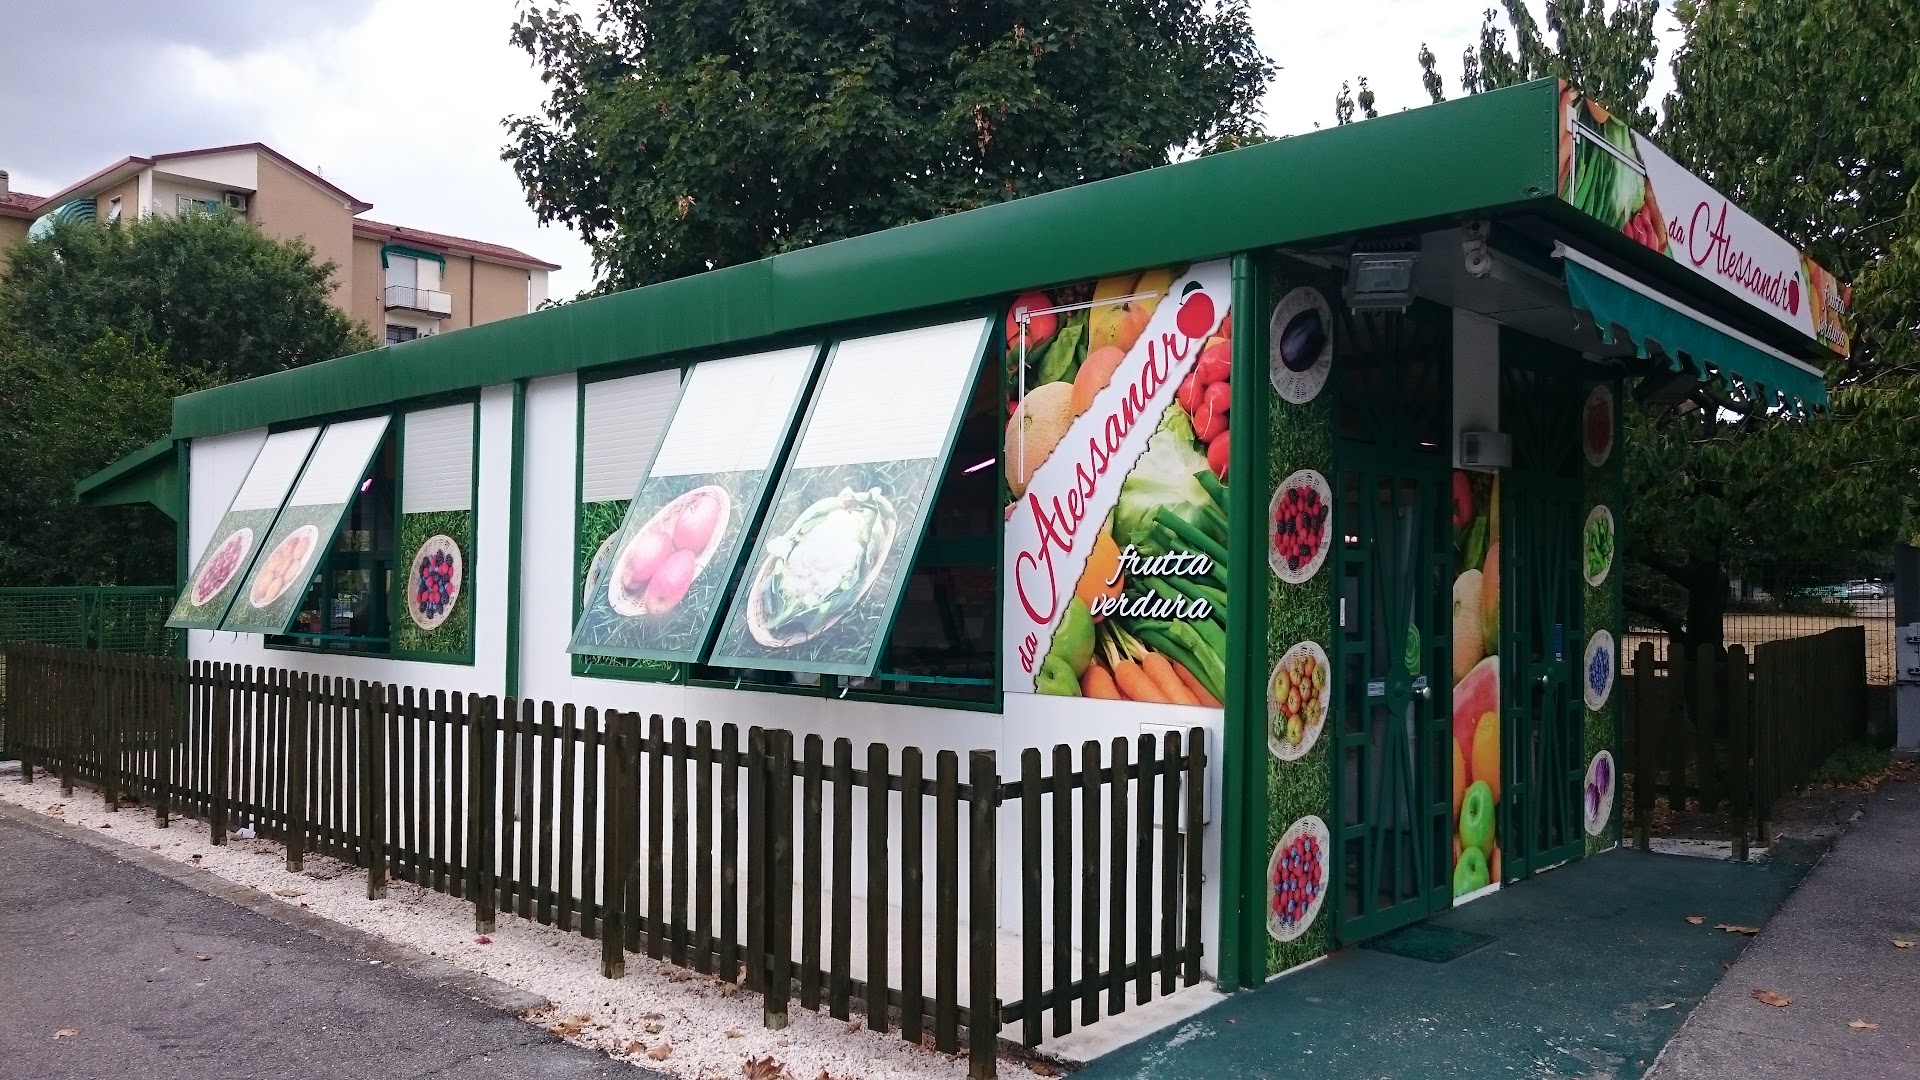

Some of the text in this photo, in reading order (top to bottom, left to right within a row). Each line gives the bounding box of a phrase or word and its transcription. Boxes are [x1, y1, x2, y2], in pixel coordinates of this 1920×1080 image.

[1668, 216, 1685, 244] da
[1821, 281, 1845, 315] frutta
[1107, 544, 1212, 585] frutta
[1090, 592, 1212, 619] verdura
[1018, 632, 1037, 674] da
